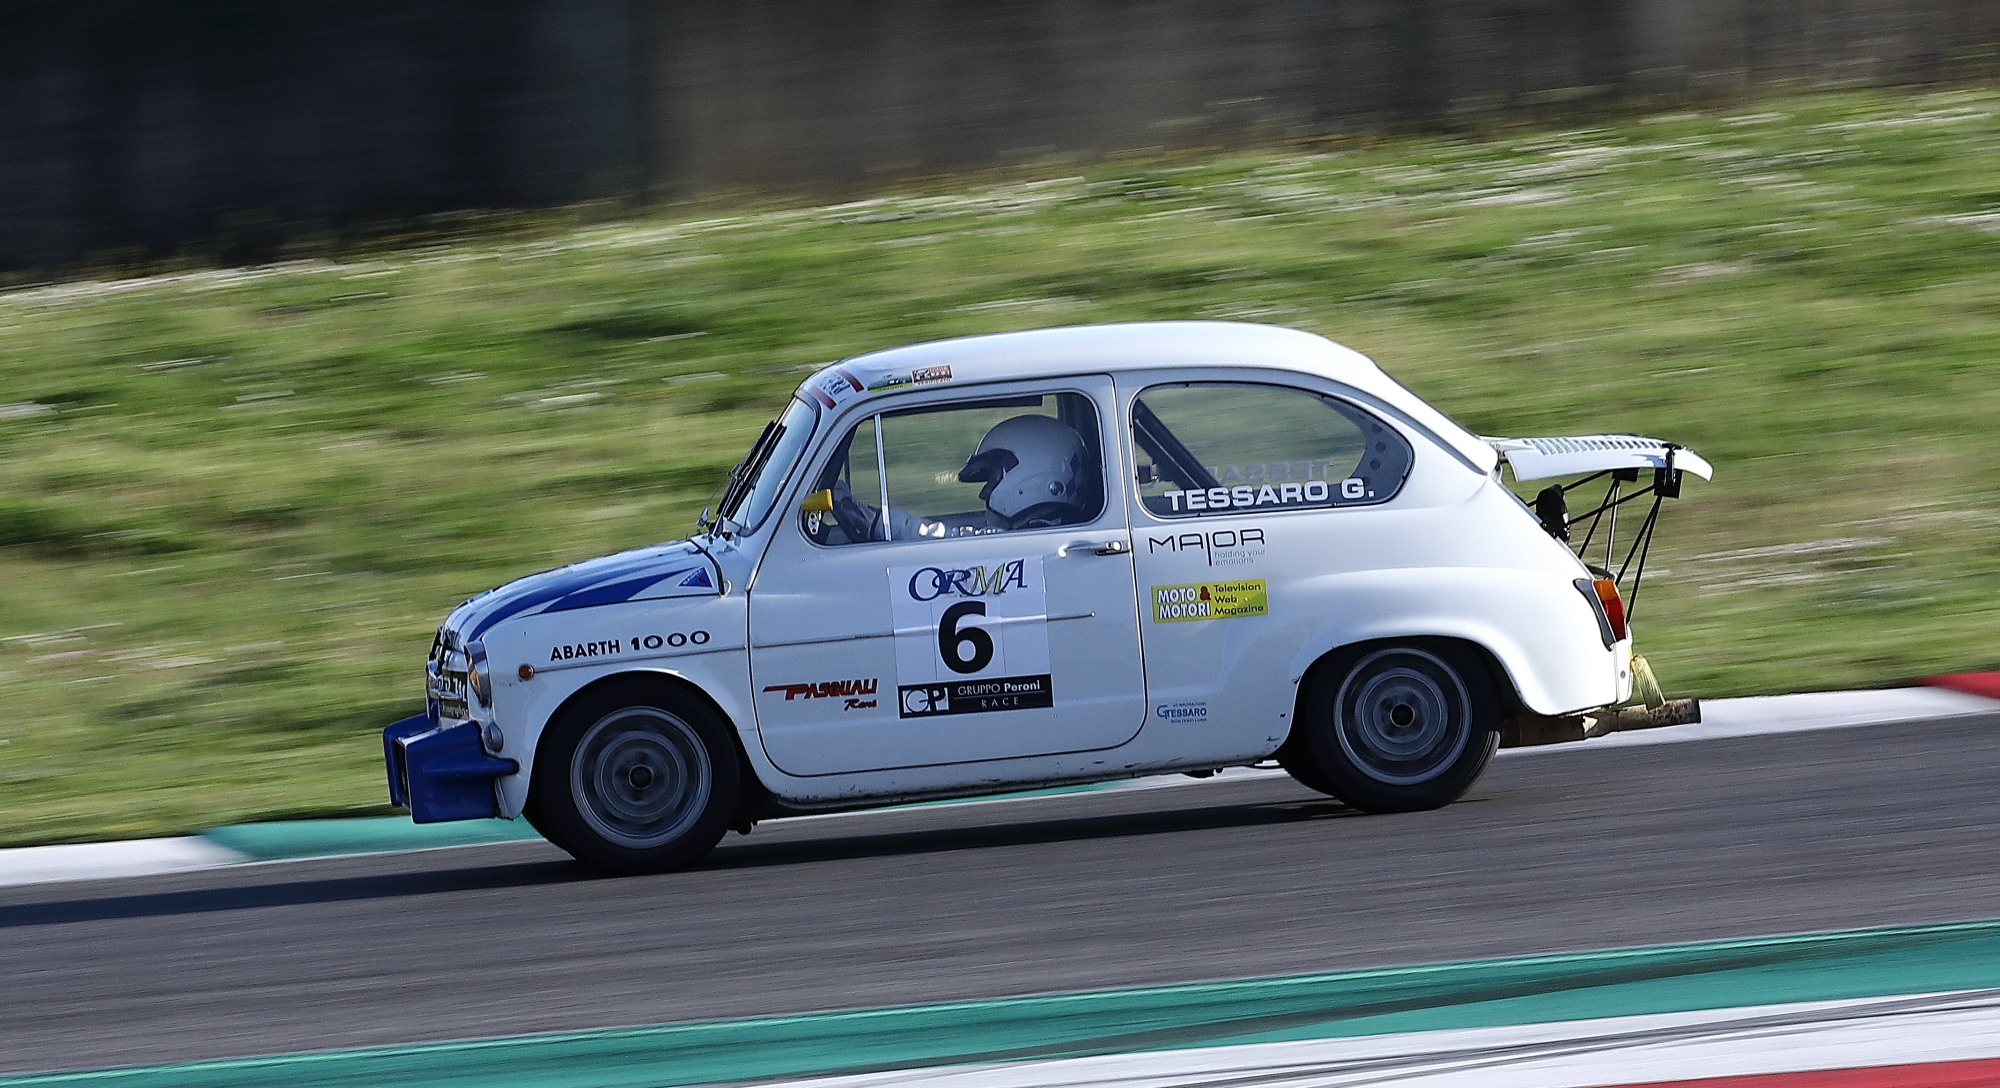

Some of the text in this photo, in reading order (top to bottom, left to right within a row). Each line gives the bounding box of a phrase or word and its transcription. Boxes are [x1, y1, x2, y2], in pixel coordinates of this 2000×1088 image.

[1164, 478, 1375, 512] TESSARO G.
[1214, 549, 1266, 559] holding your
[1215, 558, 1254, 566] emotions
[908, 558, 1028, 601] ORMA
[1157, 587, 1196, 604] MOTO
[1213, 583, 1261, 593] Television
[1214, 596, 1237, 604] Web
[1159, 602, 1211, 620] MOTORI
[1214, 605, 1264, 616] Magazine
[938, 600, 994, 674] 6
[550, 630, 711, 662] ABARTH 1000
[762, 678, 878, 701] PASQUALI
[957, 680, 1041, 696] GRUPPO Peroni
[981, 696, 1019, 708] RACE
